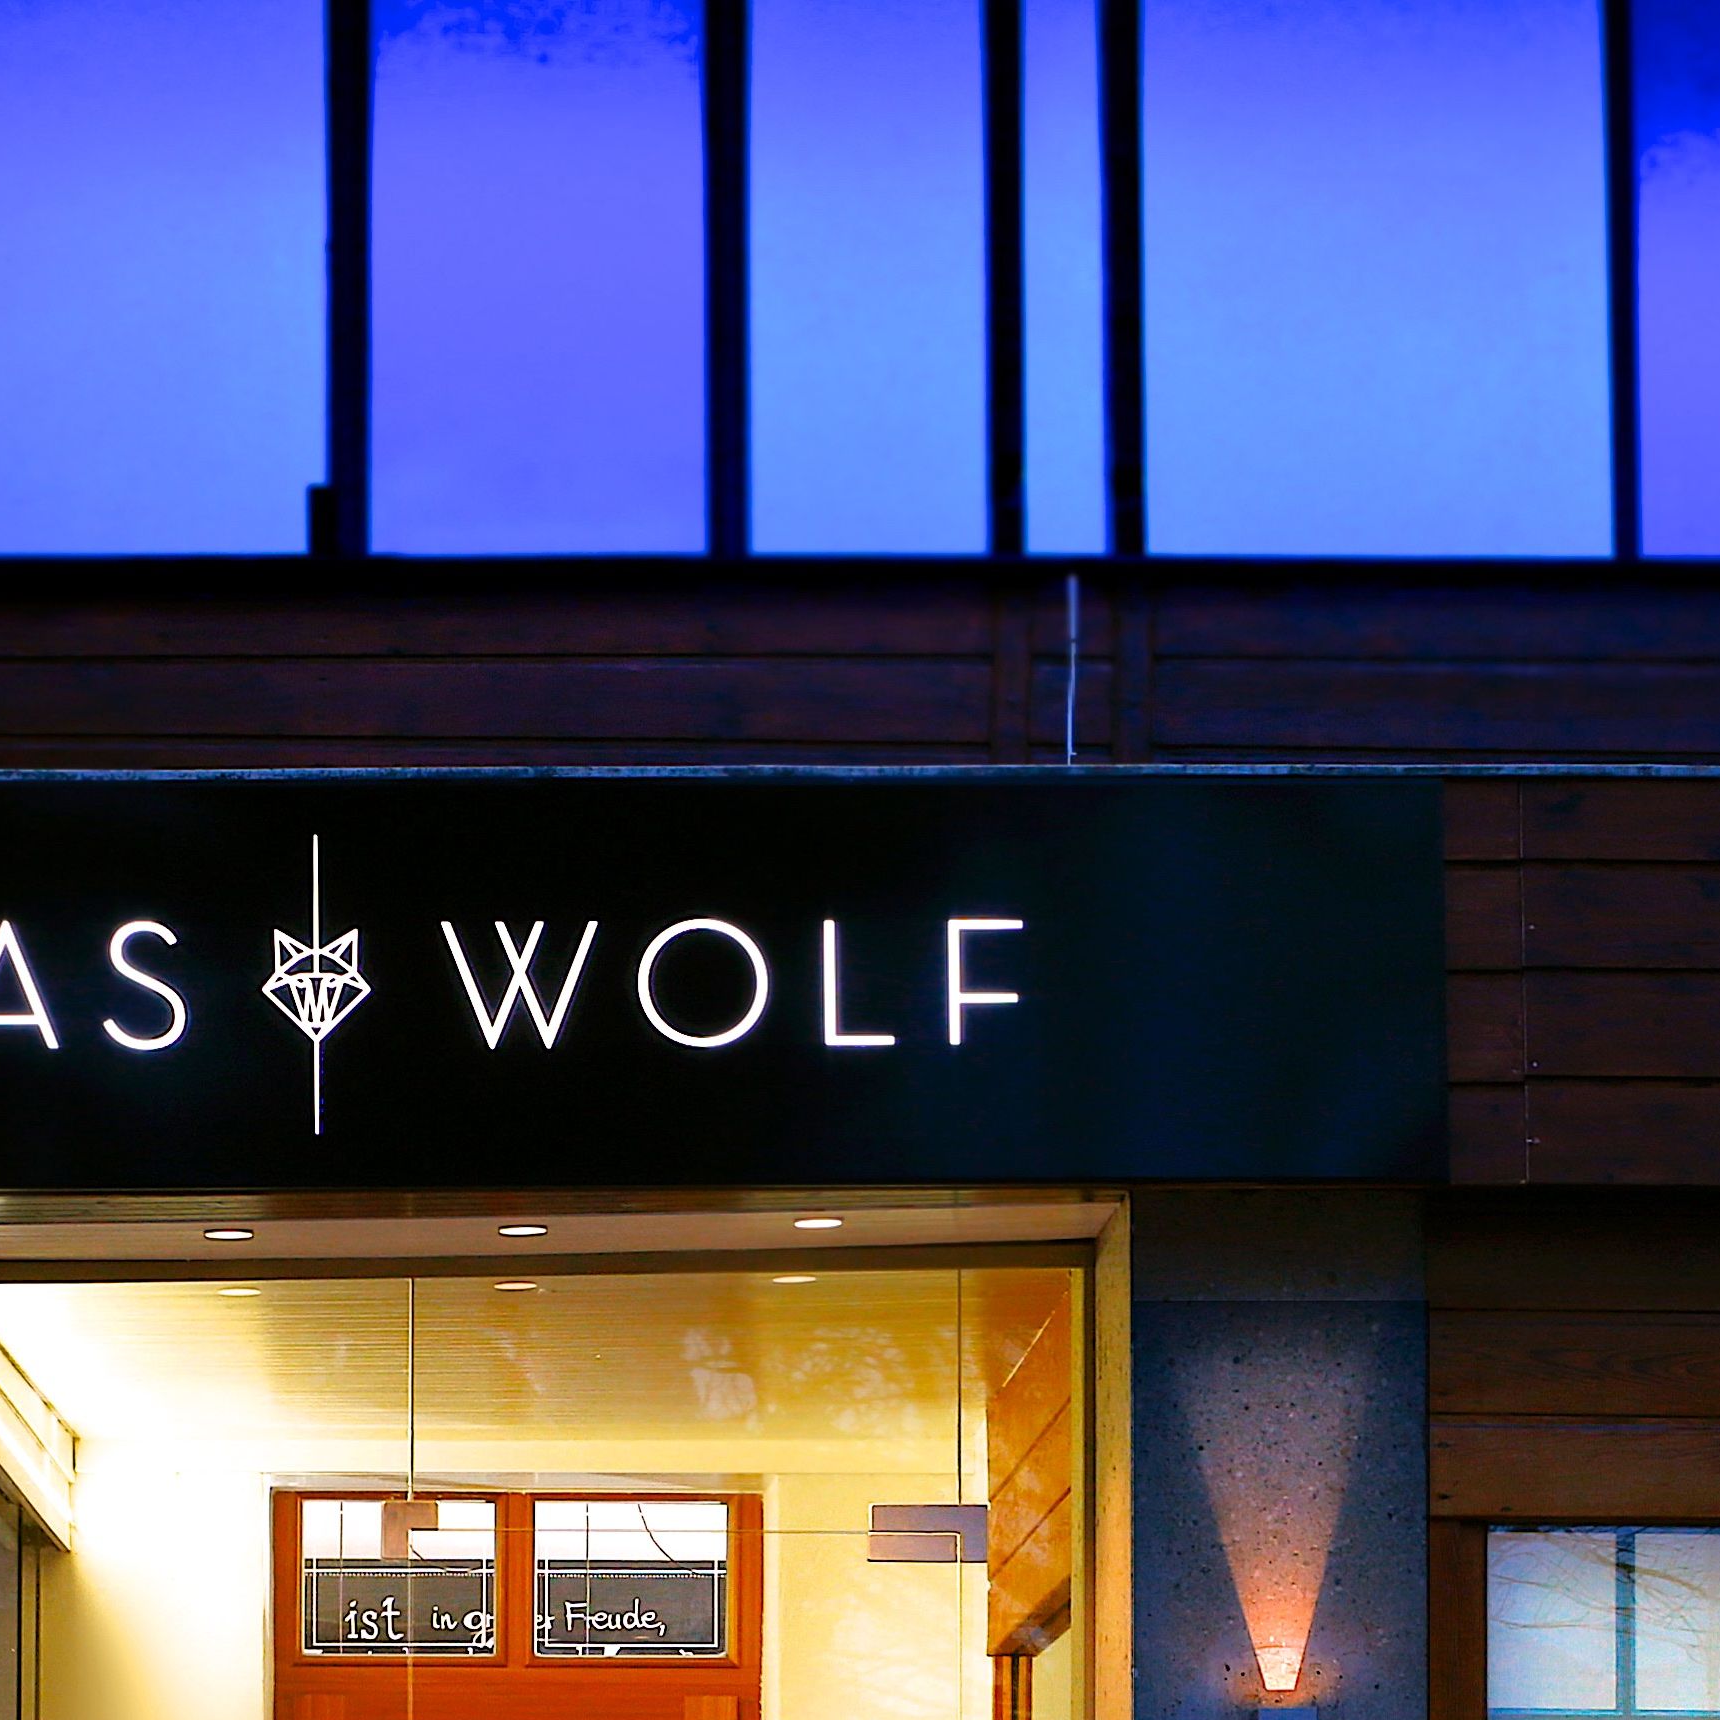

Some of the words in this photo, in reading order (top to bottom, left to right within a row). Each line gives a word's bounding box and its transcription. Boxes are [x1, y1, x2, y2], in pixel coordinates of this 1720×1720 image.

[441, 919, 1023, 1049] WOLF
[344, 1596, 405, 1641] ist
[431, 1605, 458, 1631] in
